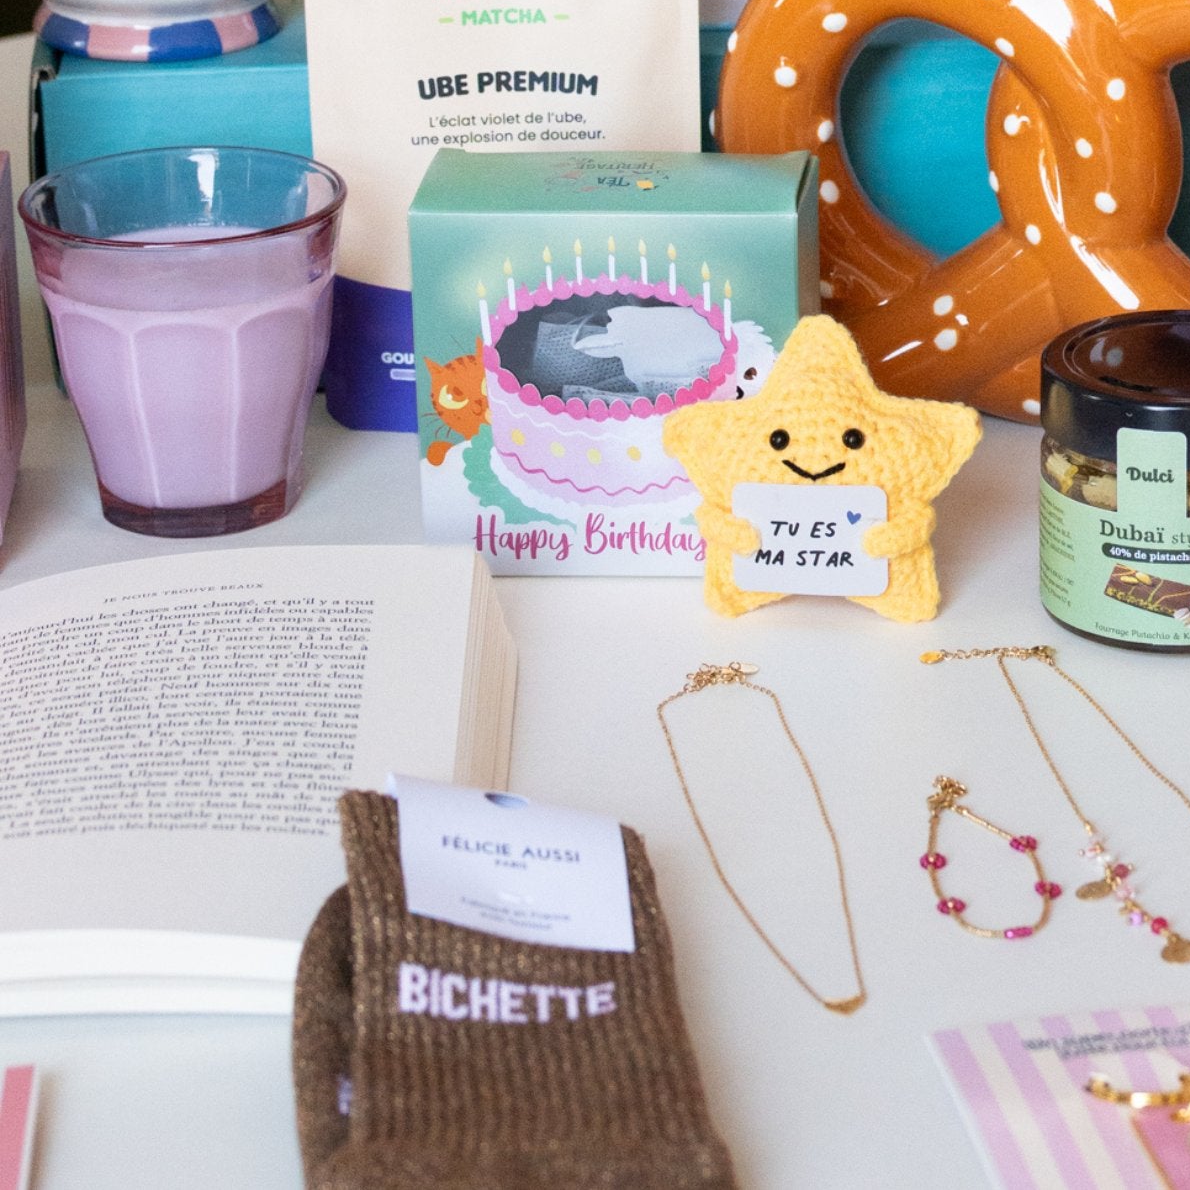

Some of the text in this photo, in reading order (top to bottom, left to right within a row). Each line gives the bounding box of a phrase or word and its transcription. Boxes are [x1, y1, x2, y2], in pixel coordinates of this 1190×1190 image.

[461, 8, 546, 26] MATCHA
[418, 70, 599, 100] UBE PREMIUM
[429, 111, 587, 129] L'éclat violet de l'ube,
[411, 128, 606, 148] une explosion de douceur.
[1126, 466, 1175, 484] Dulci
[473, 513, 707, 562] Happy Birthday
[770, 520, 837, 538] TU ES
[1099, 518, 1165, 544] Dubaï
[755, 548, 855, 568] MA STAR
[1109, 546, 1132, 559] 40%
[1134, 549, 1147, 561] de
[522, 846, 580, 863] AUSSI
[399, 961, 618, 1025] BICHETTE
